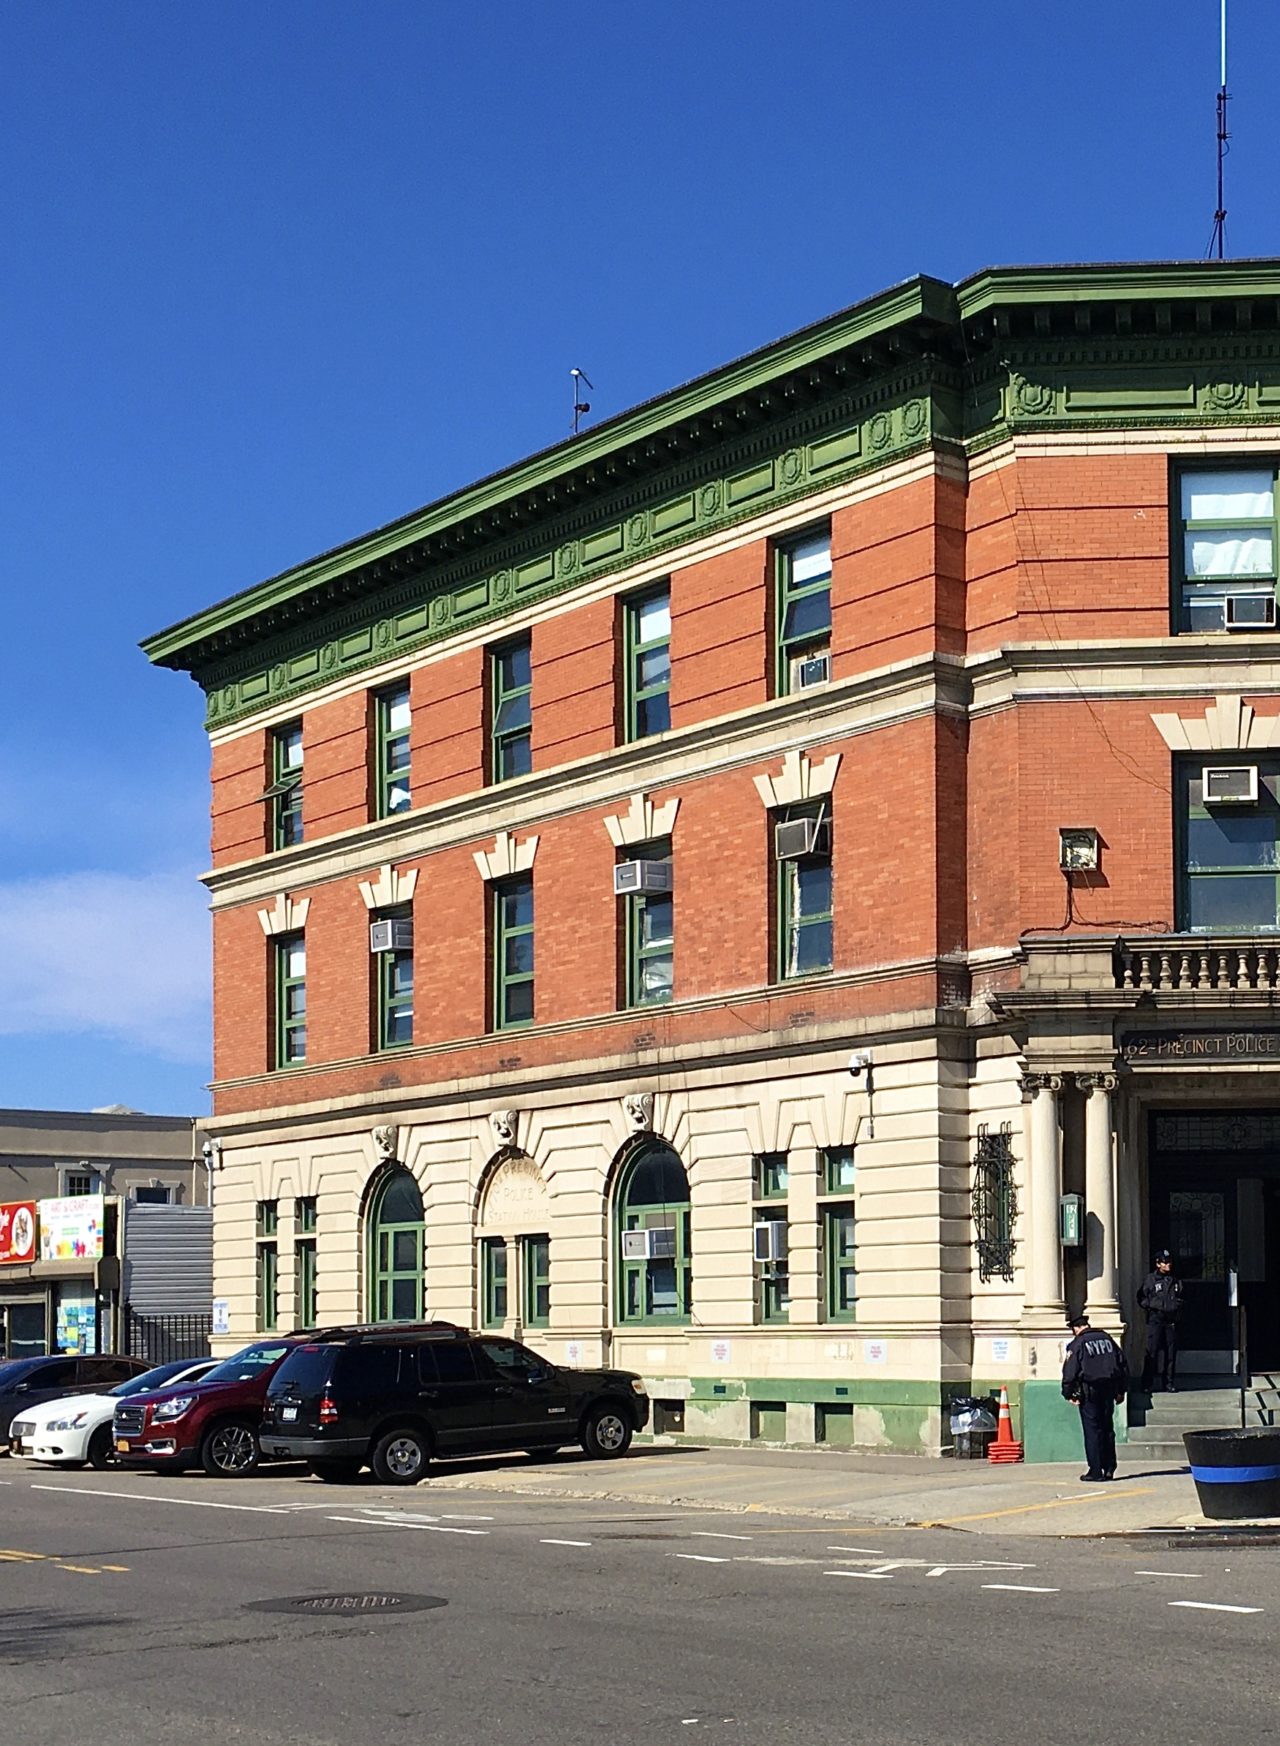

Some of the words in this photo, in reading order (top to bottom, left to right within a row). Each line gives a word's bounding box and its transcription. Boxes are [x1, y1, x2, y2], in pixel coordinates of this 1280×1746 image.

[1158, 1037, 1223, 1055] PRECINCT
[1226, 1036, 1278, 1053] POLICE
[1085, 1339, 1113, 1356] NYPD
